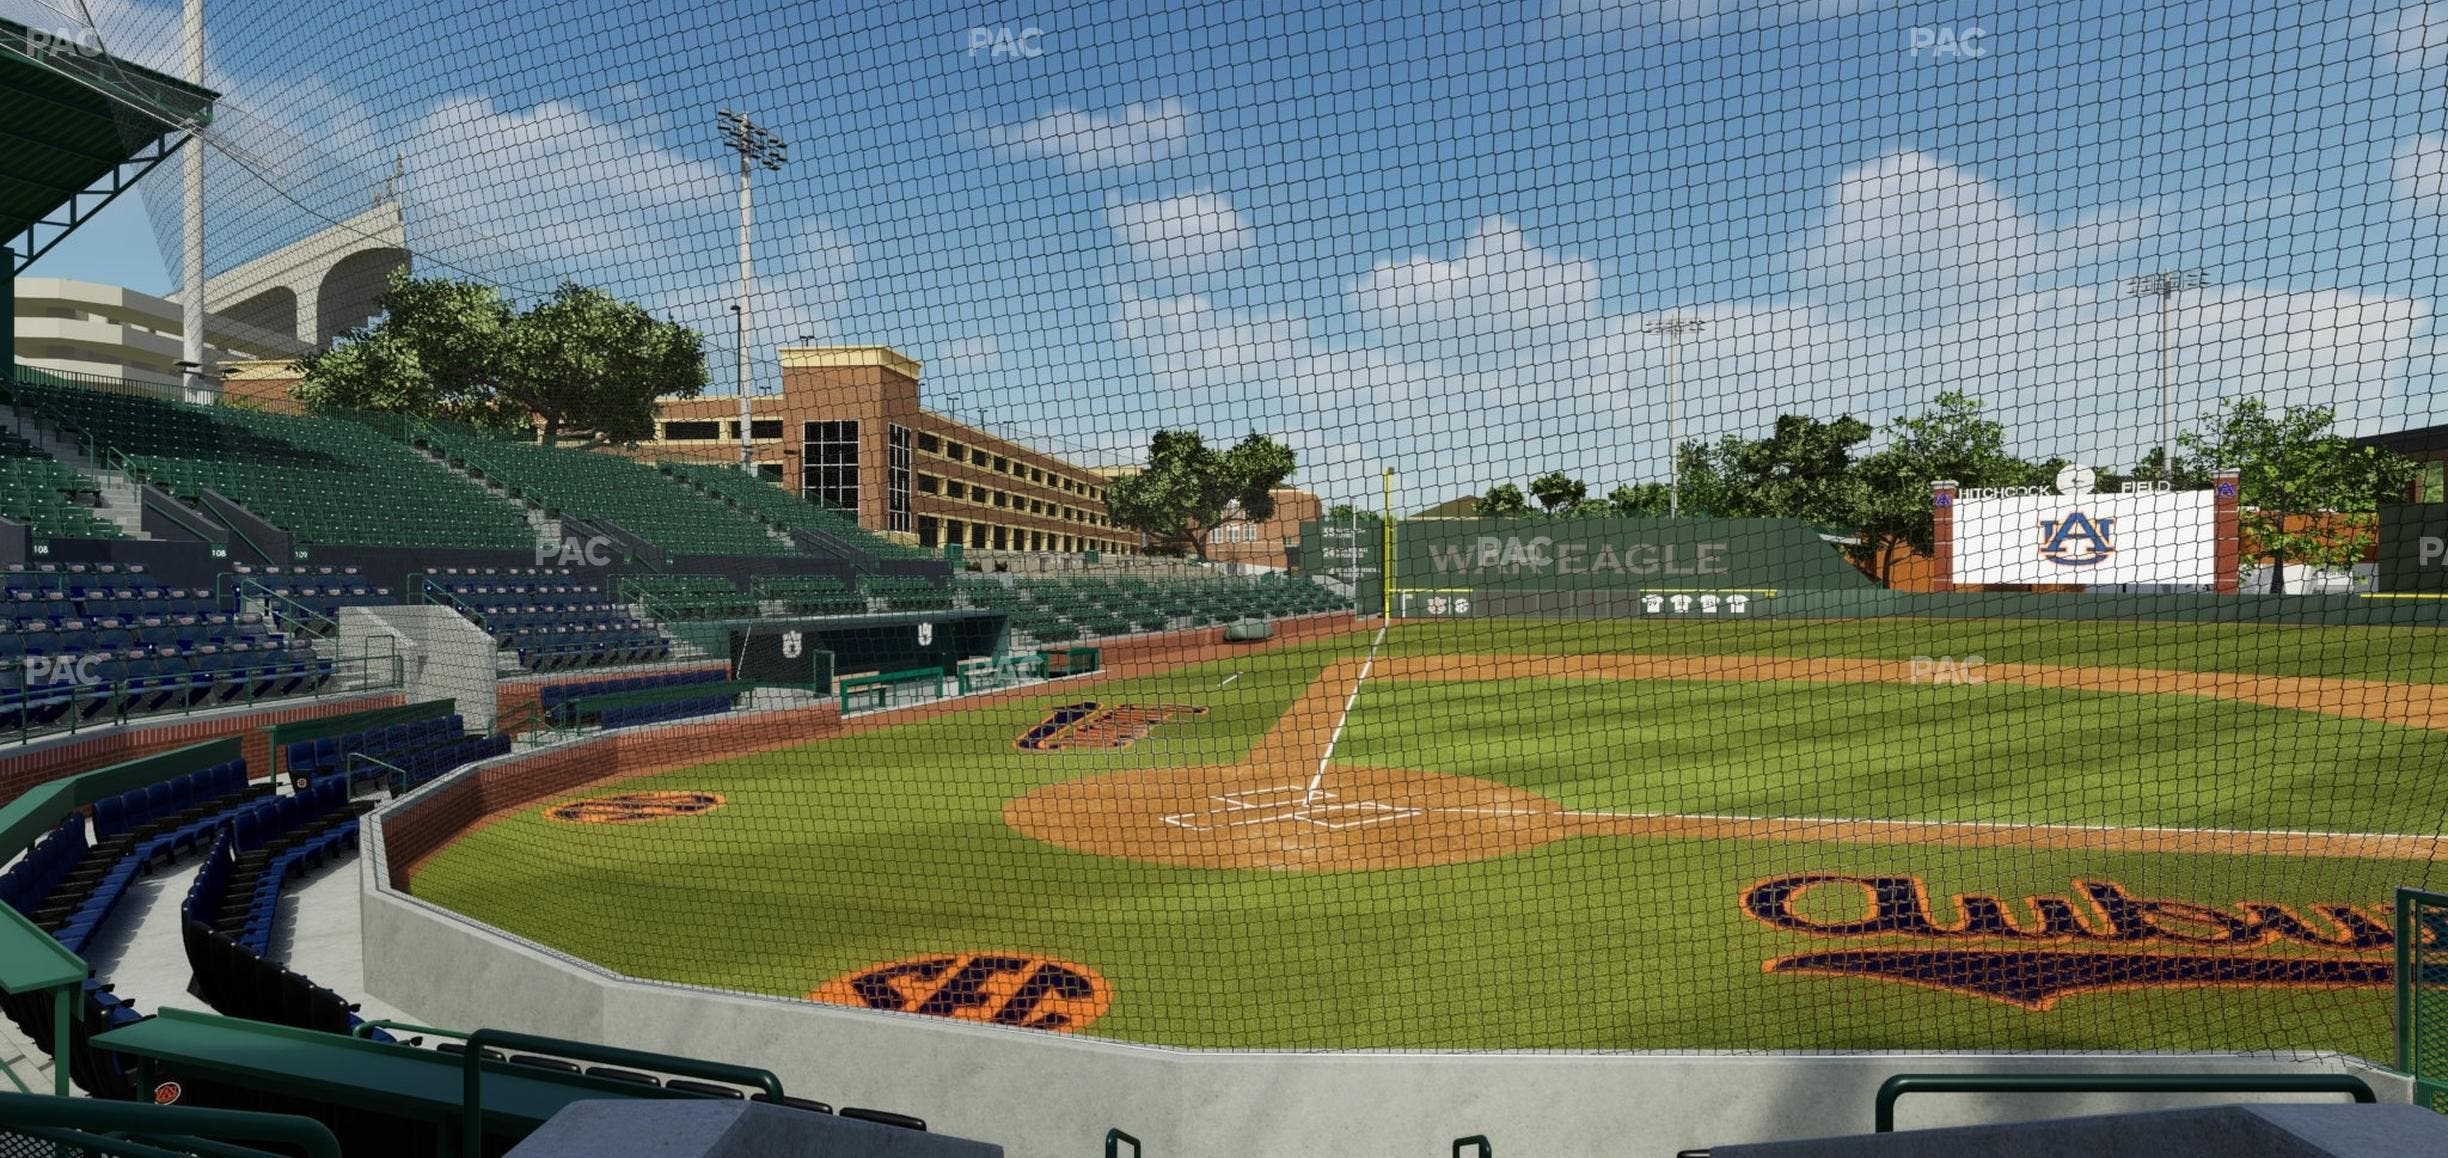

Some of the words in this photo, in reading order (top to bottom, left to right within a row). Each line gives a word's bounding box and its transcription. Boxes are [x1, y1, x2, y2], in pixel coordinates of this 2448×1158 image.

[1959, 485, 2050, 500] HITCHCOCK
[2121, 480, 2170, 493] FIELD
[33, 545, 49, 554] 108
[211, 549, 227, 558] 108
[1555, 543, 1728, 576] EAGLE
